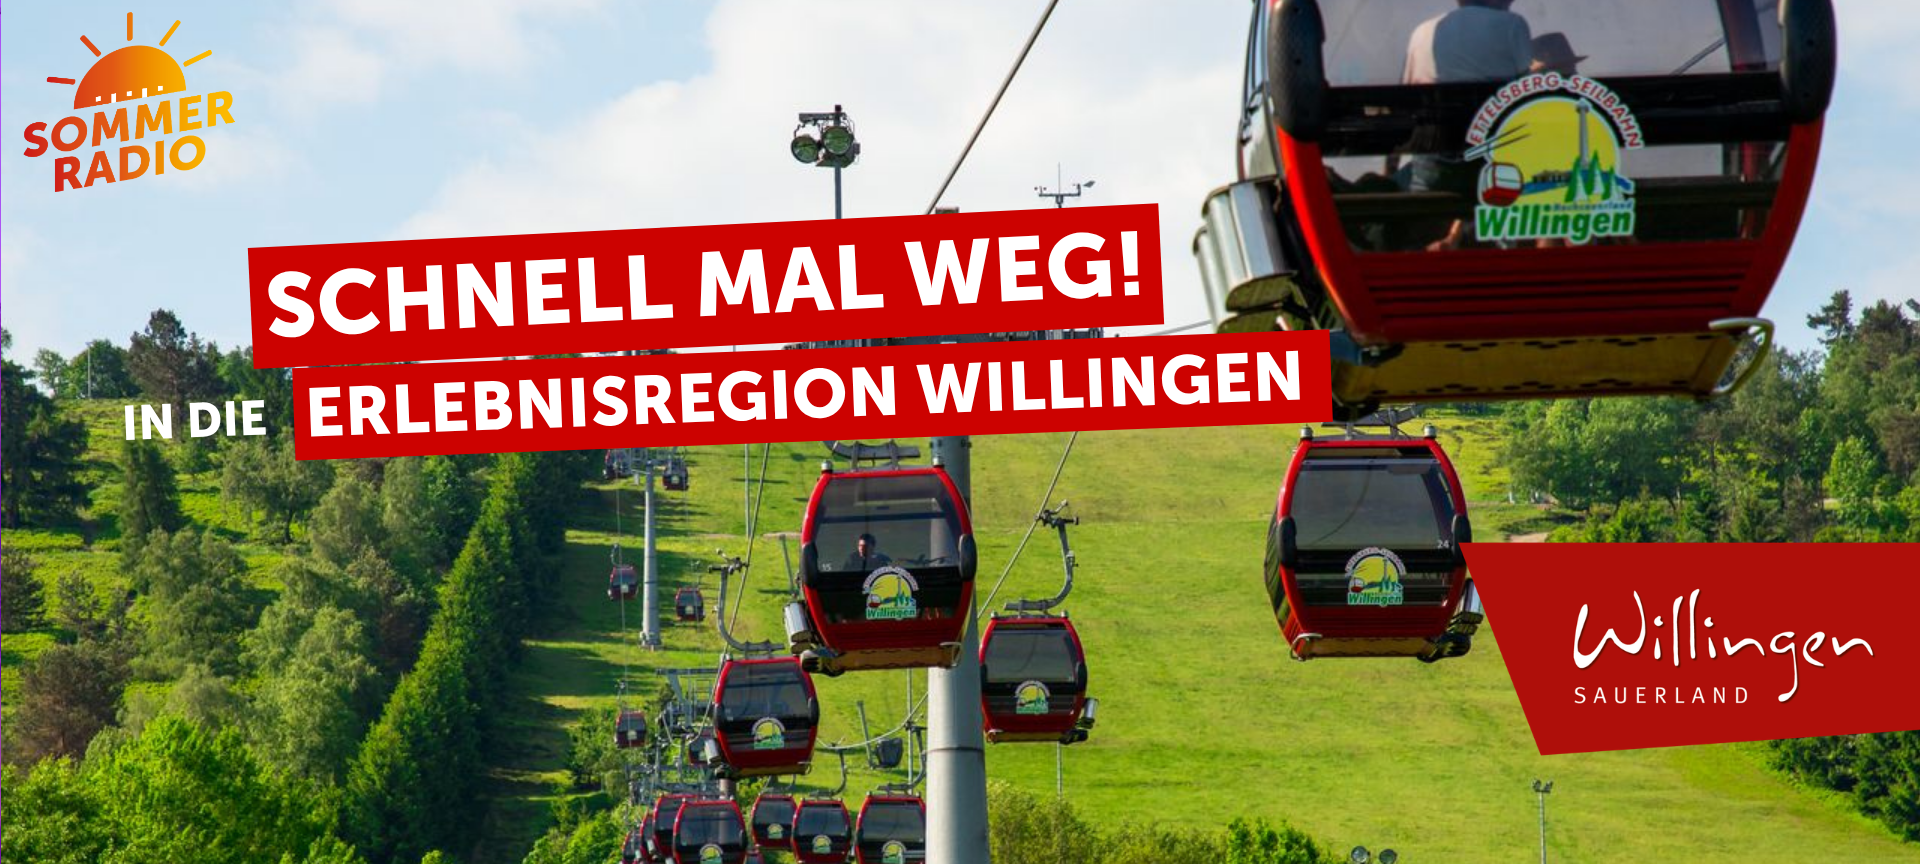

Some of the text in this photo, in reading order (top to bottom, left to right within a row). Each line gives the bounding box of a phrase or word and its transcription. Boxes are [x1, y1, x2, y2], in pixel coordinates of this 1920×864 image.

[1466, 72, 1645, 148] ETTELSBERG-SEILBAHN
[1476, 203, 1632, 242] Willingen
[866, 606, 917, 620] Willingen
[1348, 592, 1403, 607] Willingen
